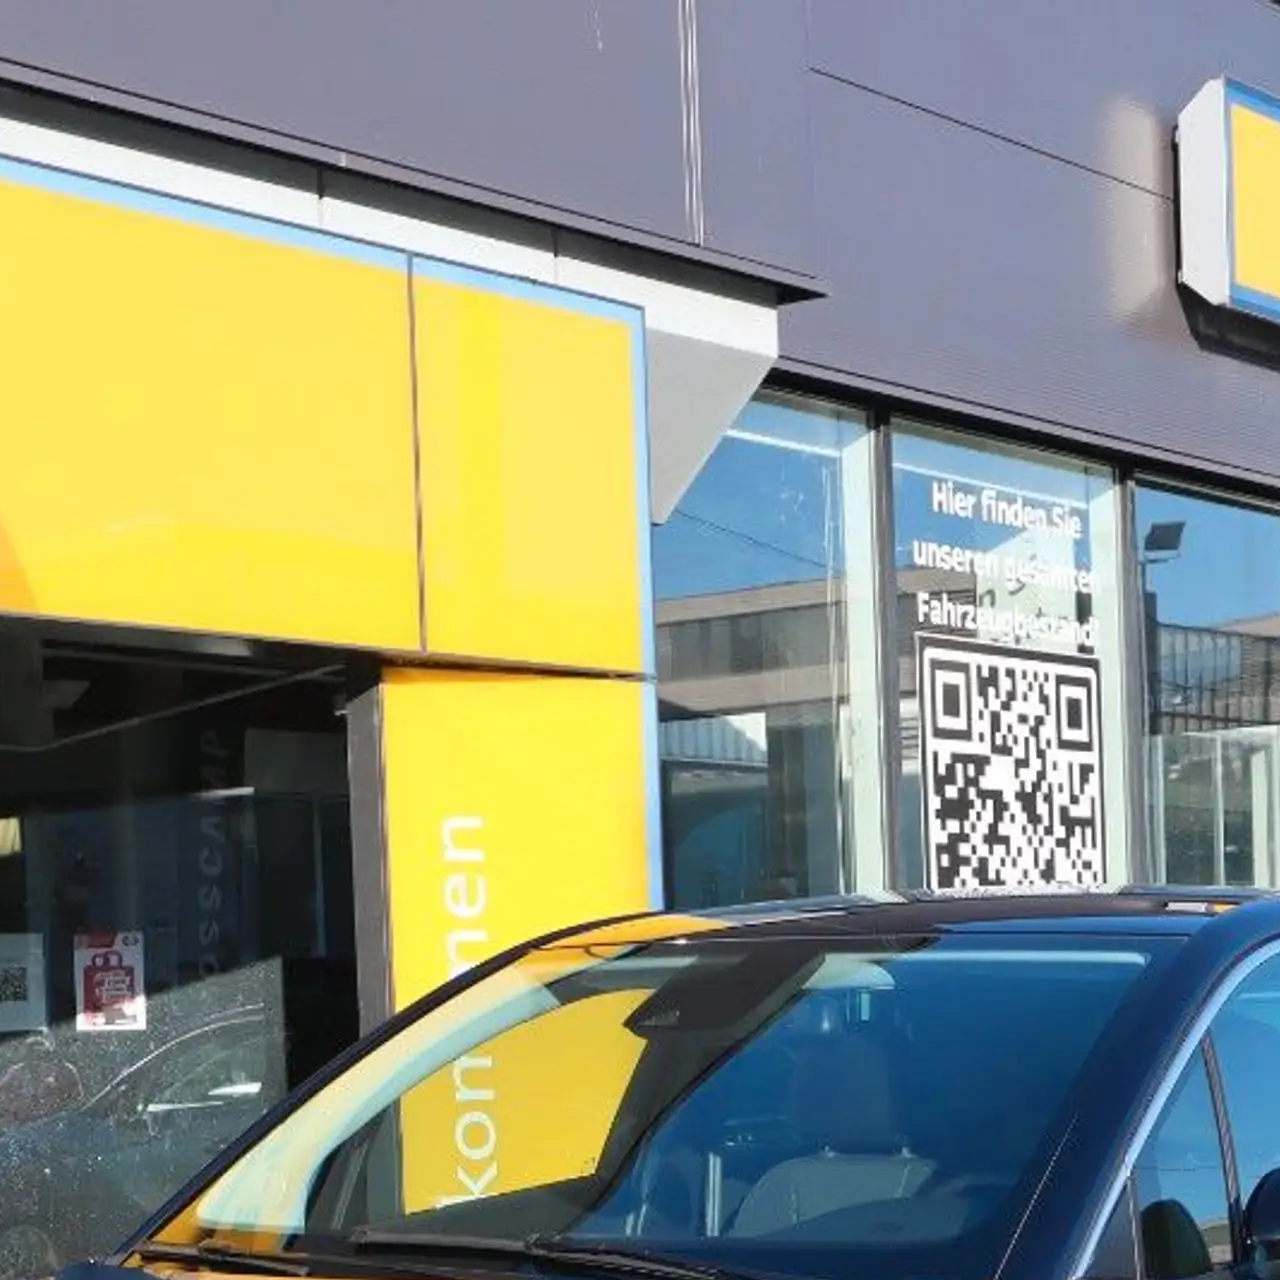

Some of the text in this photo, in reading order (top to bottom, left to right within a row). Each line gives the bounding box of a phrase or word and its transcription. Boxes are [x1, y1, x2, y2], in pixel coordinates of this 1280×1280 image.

[932, 480, 1083, 540] Hier finden Sie
[912, 538, 999, 578] unseren
